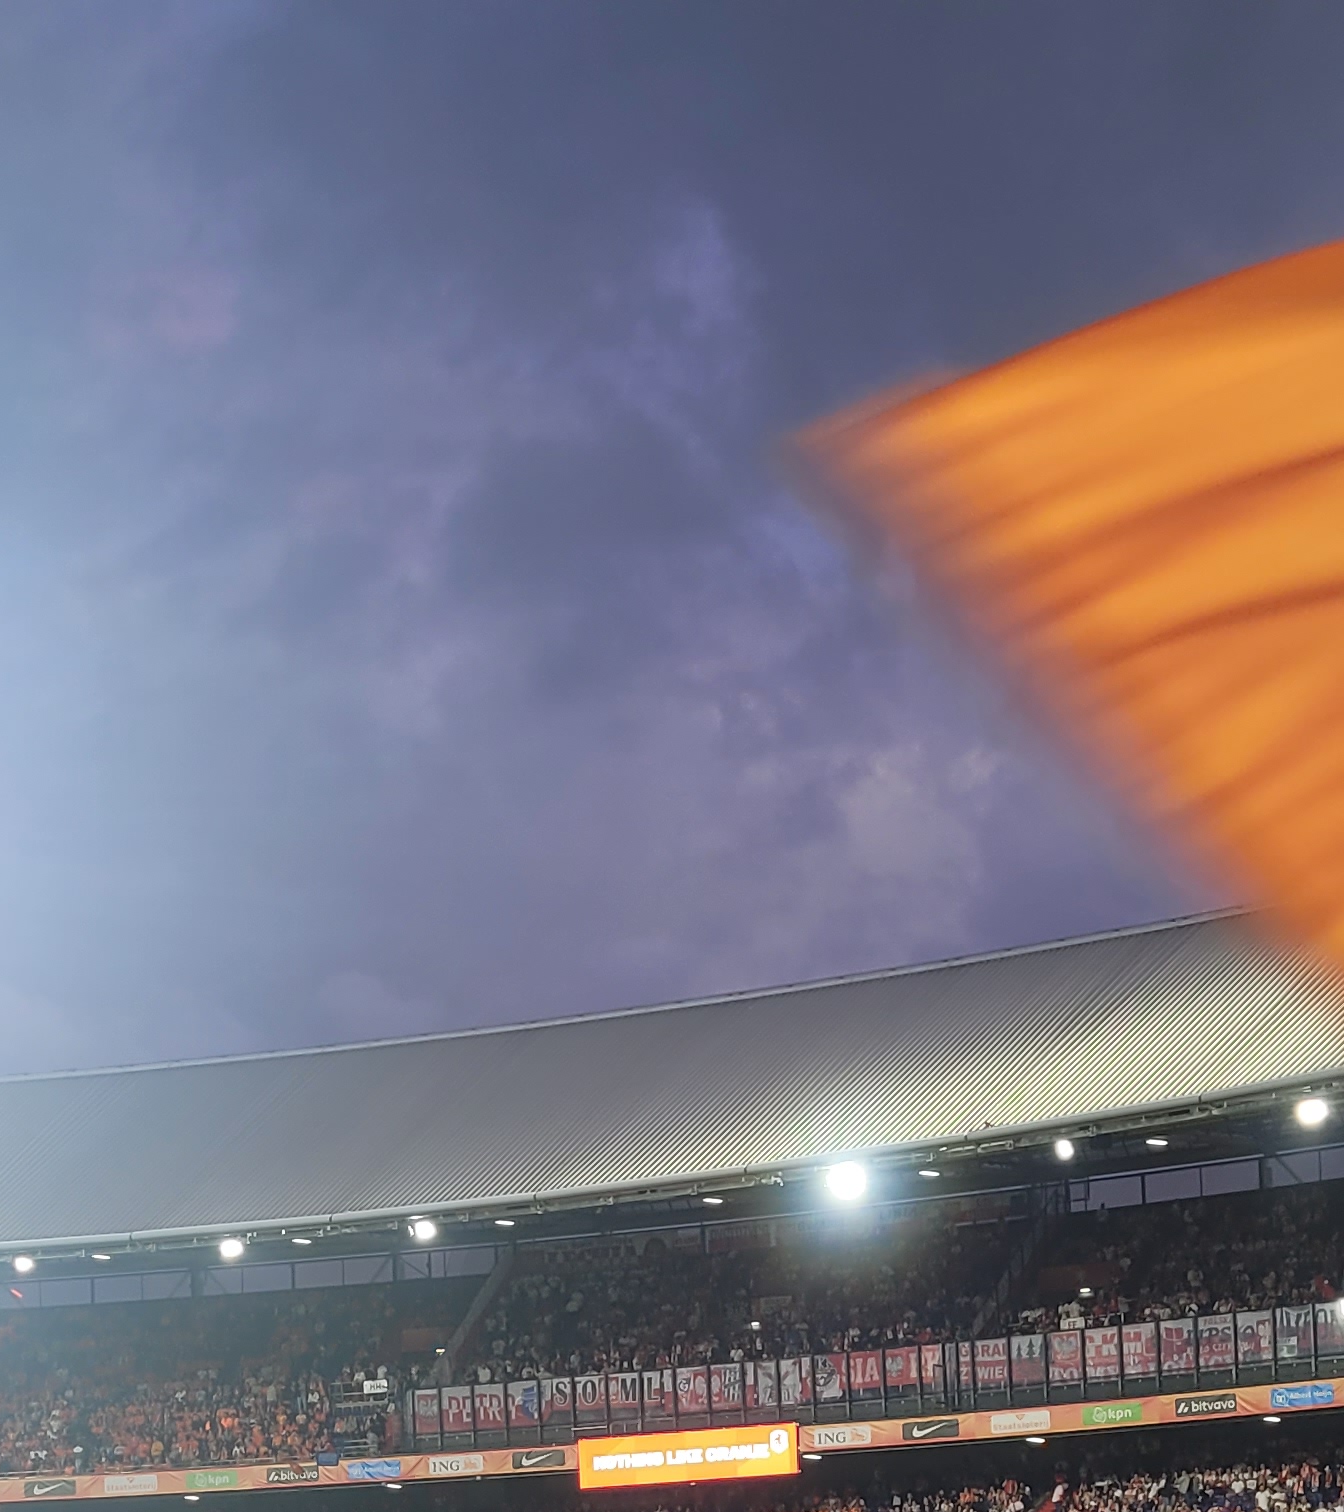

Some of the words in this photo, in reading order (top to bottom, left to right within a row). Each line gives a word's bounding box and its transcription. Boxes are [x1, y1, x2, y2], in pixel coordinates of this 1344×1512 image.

[1190, 1398, 1236, 1413] bitvavo
[1107, 1405, 1133, 1423] kpn
[817, 1431, 847, 1444] ING
[666, 1447, 703, 1466] LIKE
[433, 1460, 460, 1473] ING
[207, 1474, 230, 1488] kpn
